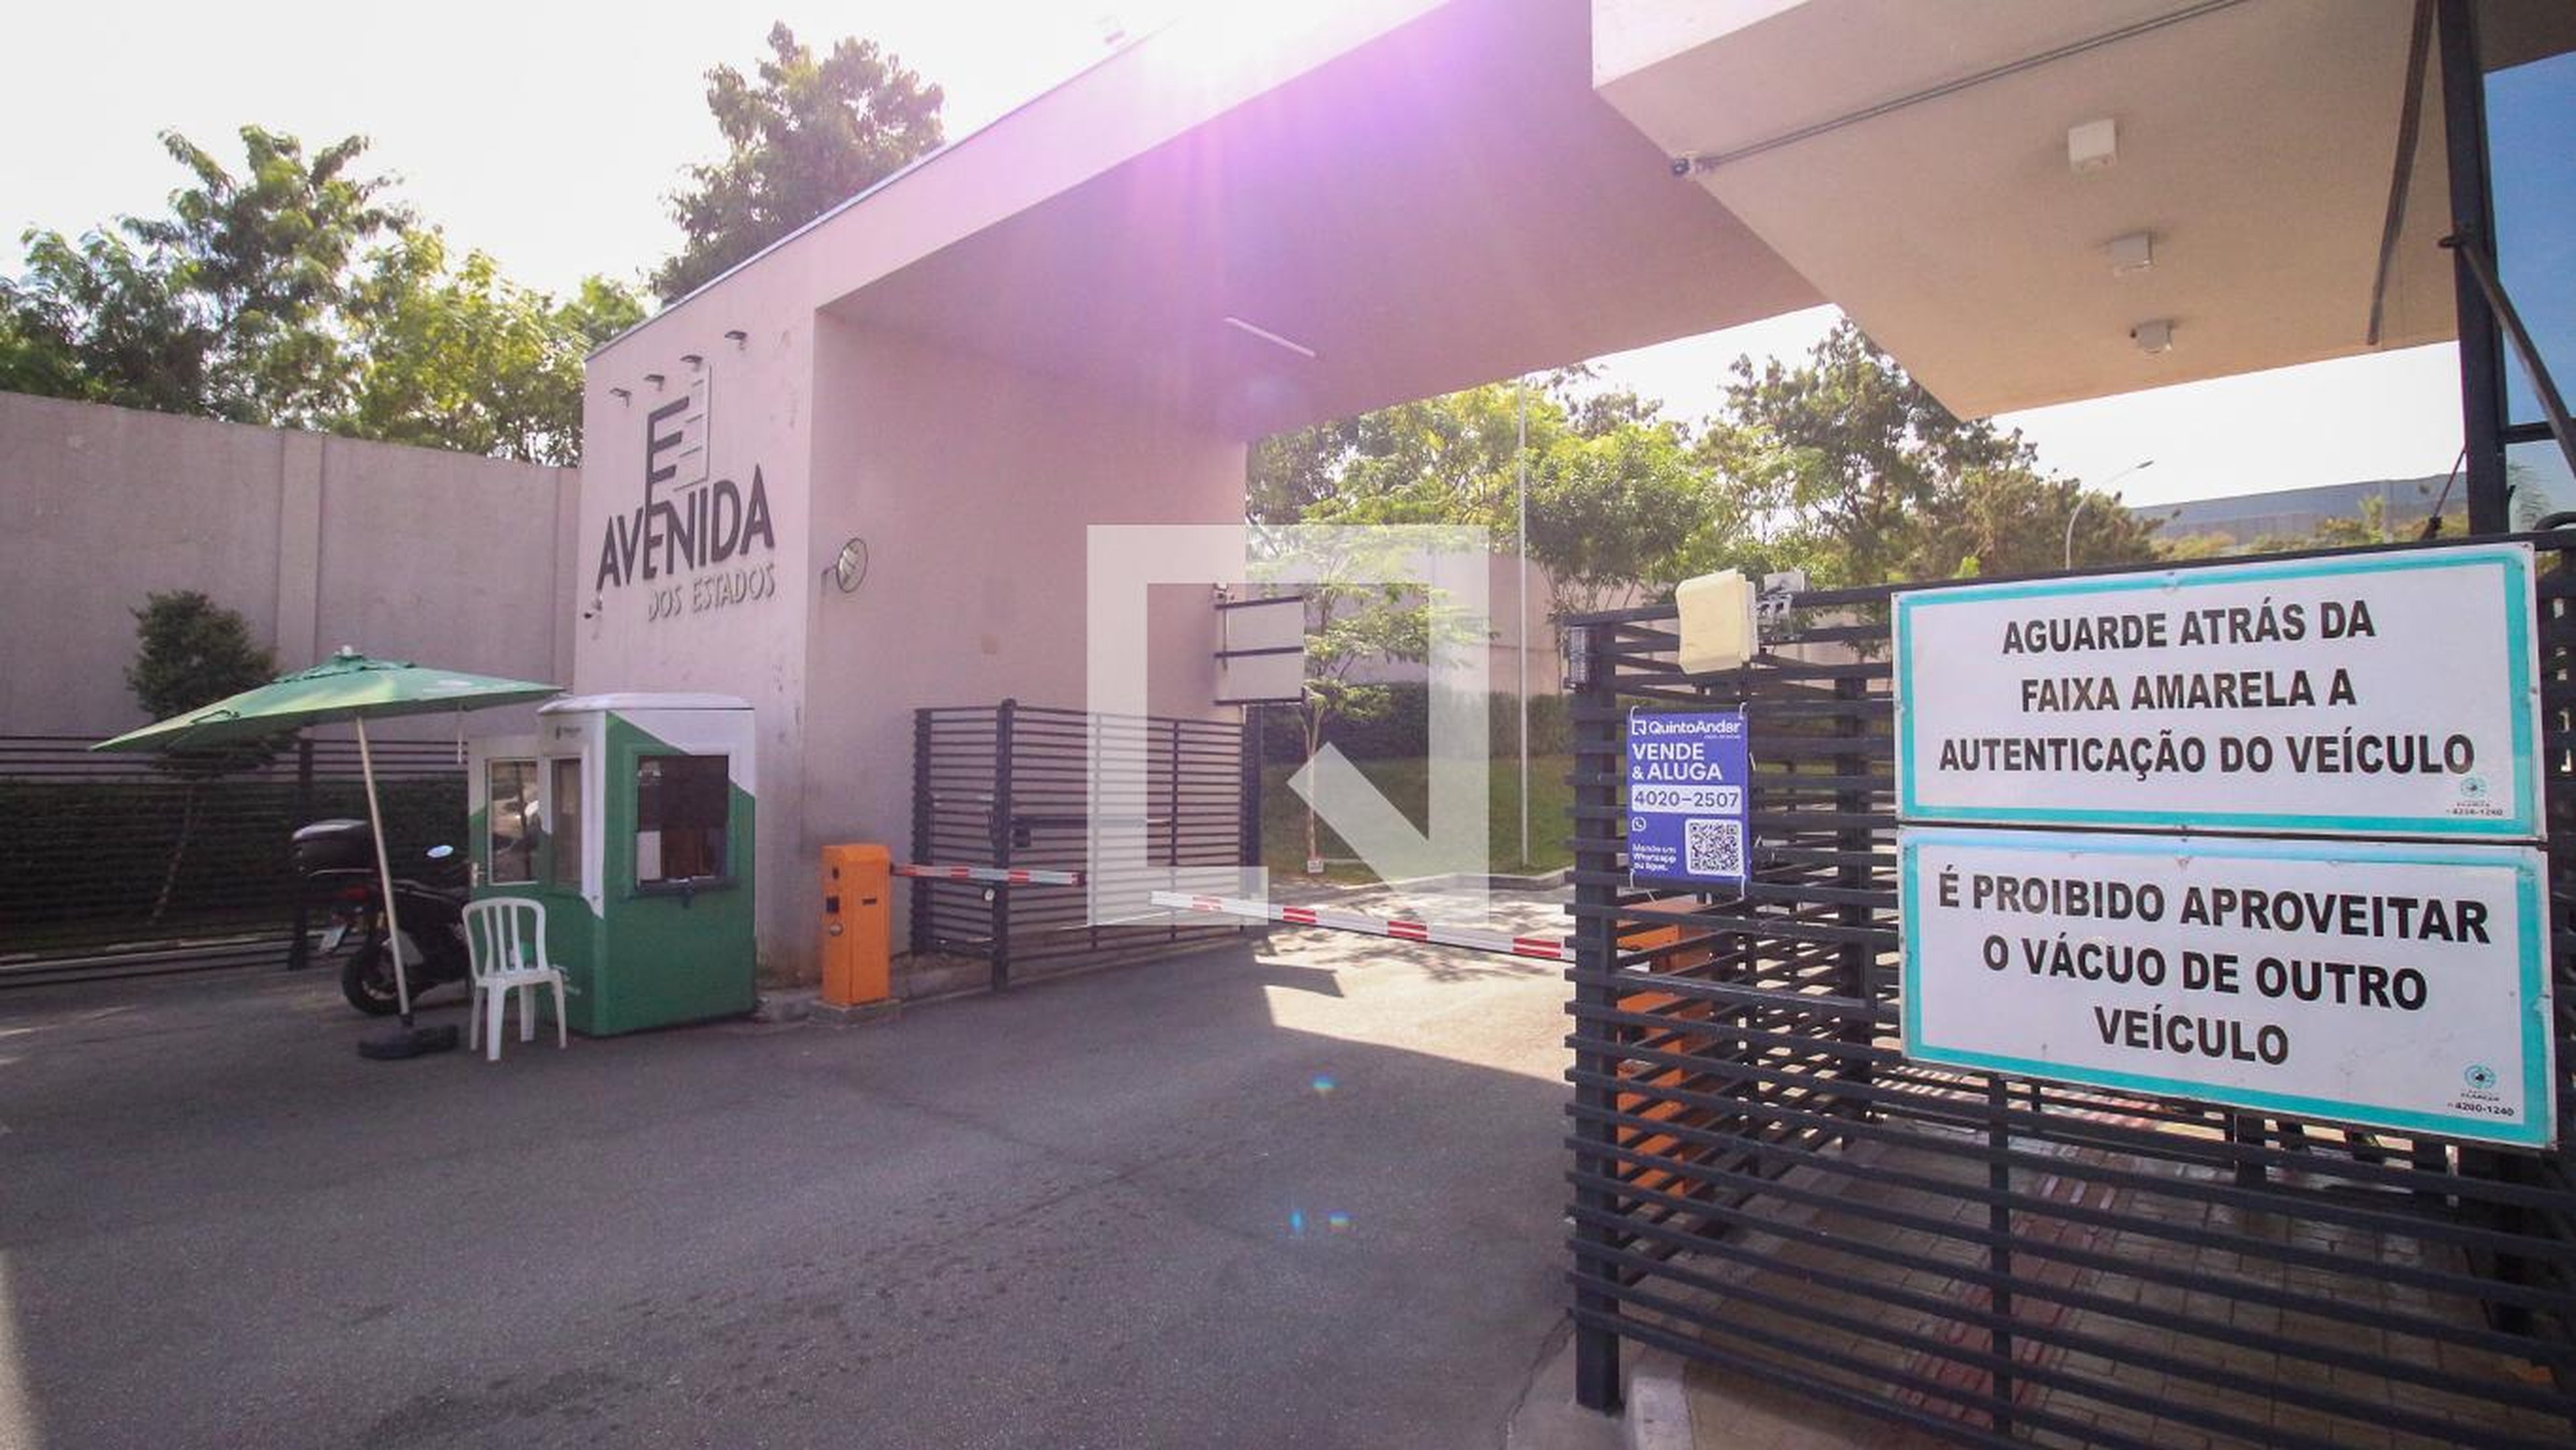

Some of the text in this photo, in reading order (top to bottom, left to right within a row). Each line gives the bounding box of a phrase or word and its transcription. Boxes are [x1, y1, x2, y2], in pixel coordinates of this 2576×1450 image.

[595, 463, 775, 592] AVENIDA
[649, 564, 775, 623] DOS ESTADOS
[2002, 597, 2376, 654] AGUARDE ATRÁS DA
[2022, 668, 2357, 713] FAIXA AMARELA A
[1632, 743, 1705, 760] VENDE
[1632, 764, 1723, 780] & ALUGA
[1939, 727, 2475, 782] AUTENTICAÇÃO DO VEÍCULO
[1634, 790, 1739, 807] 4020-2507
[1939, 865, 2491, 945] É PROIBIDO APROVEITAR
[1983, 932, 2428, 1011] O VÁCUO DE OUTRO
[2094, 1004, 2289, 1066] VEÍCULO
